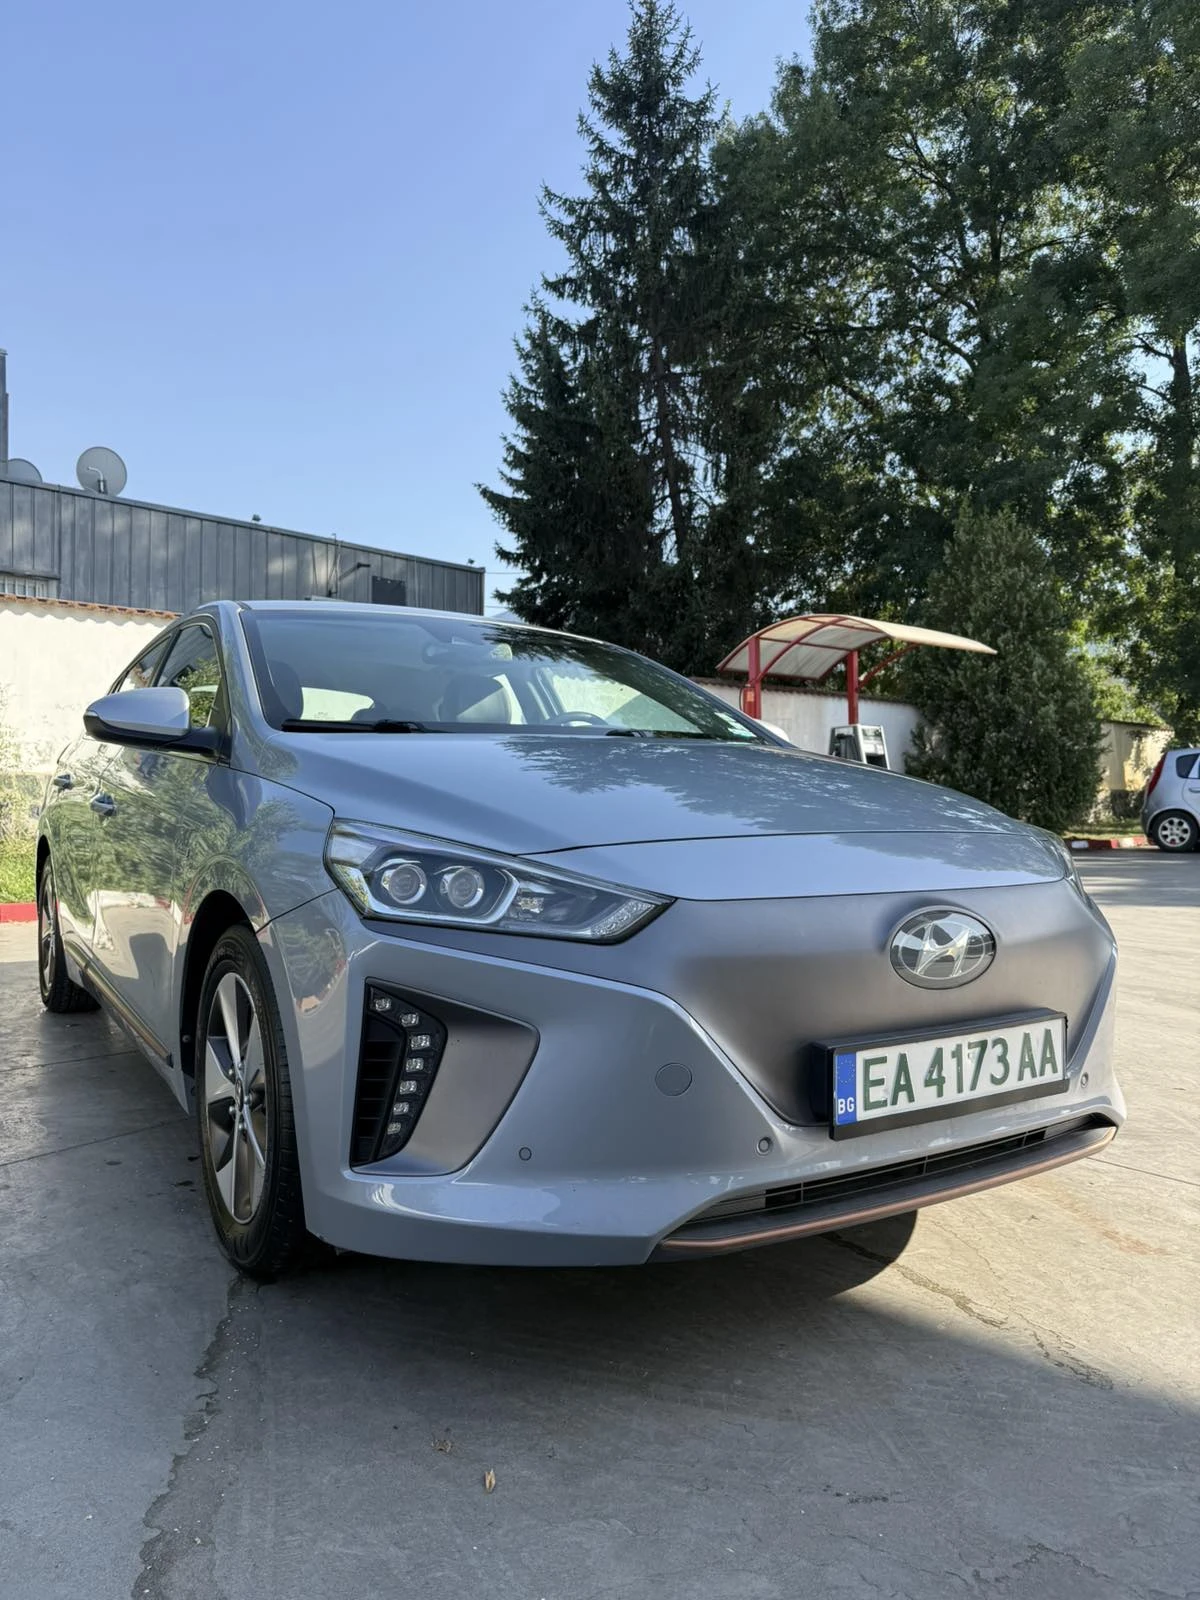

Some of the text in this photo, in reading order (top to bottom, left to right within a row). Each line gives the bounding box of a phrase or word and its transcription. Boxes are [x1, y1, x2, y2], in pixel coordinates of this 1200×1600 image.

[863, 1028, 1058, 1111] EA 4173 AA
[837, 1097, 855, 1115] BG
